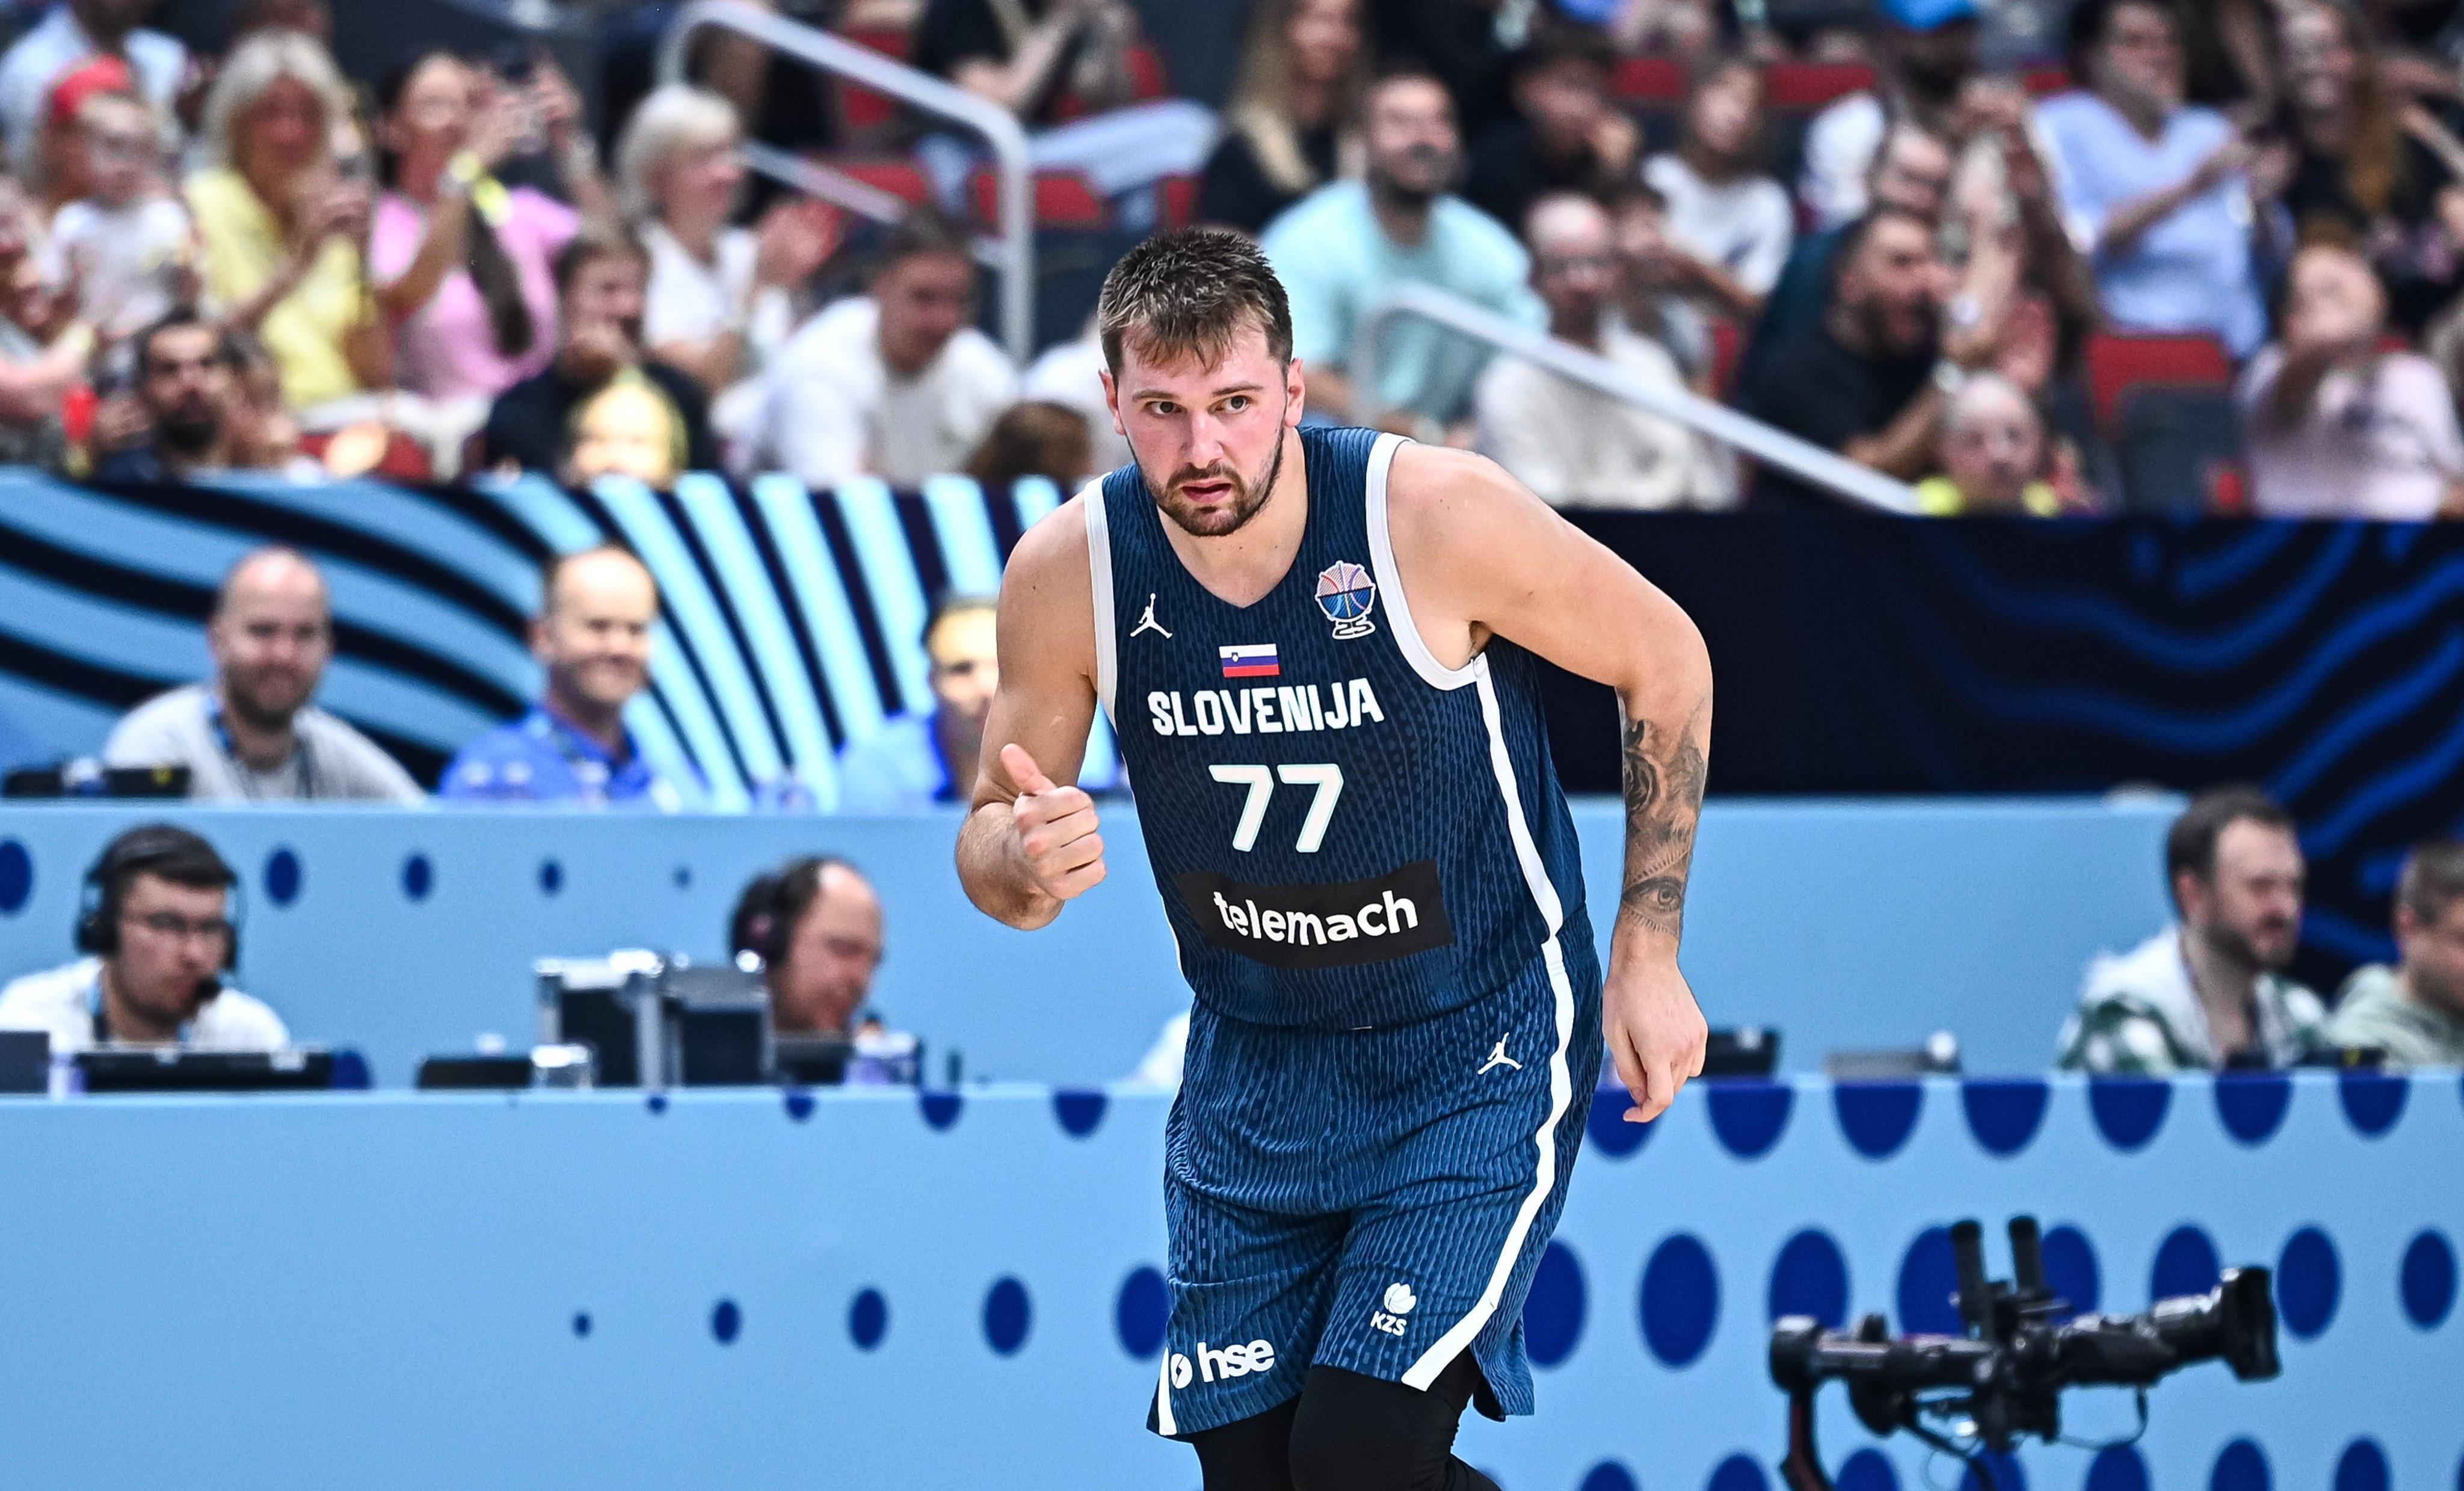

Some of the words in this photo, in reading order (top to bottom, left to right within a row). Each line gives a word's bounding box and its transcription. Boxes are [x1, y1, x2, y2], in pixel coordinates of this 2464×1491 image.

[1147, 678, 1384, 736] SLOVENIJA
[1209, 763, 1344, 853] 77
[1213, 890, 1418, 945] telemach
[1370, 1311, 1407, 1336] KZS
[1197, 1339, 1275, 1383] hse
